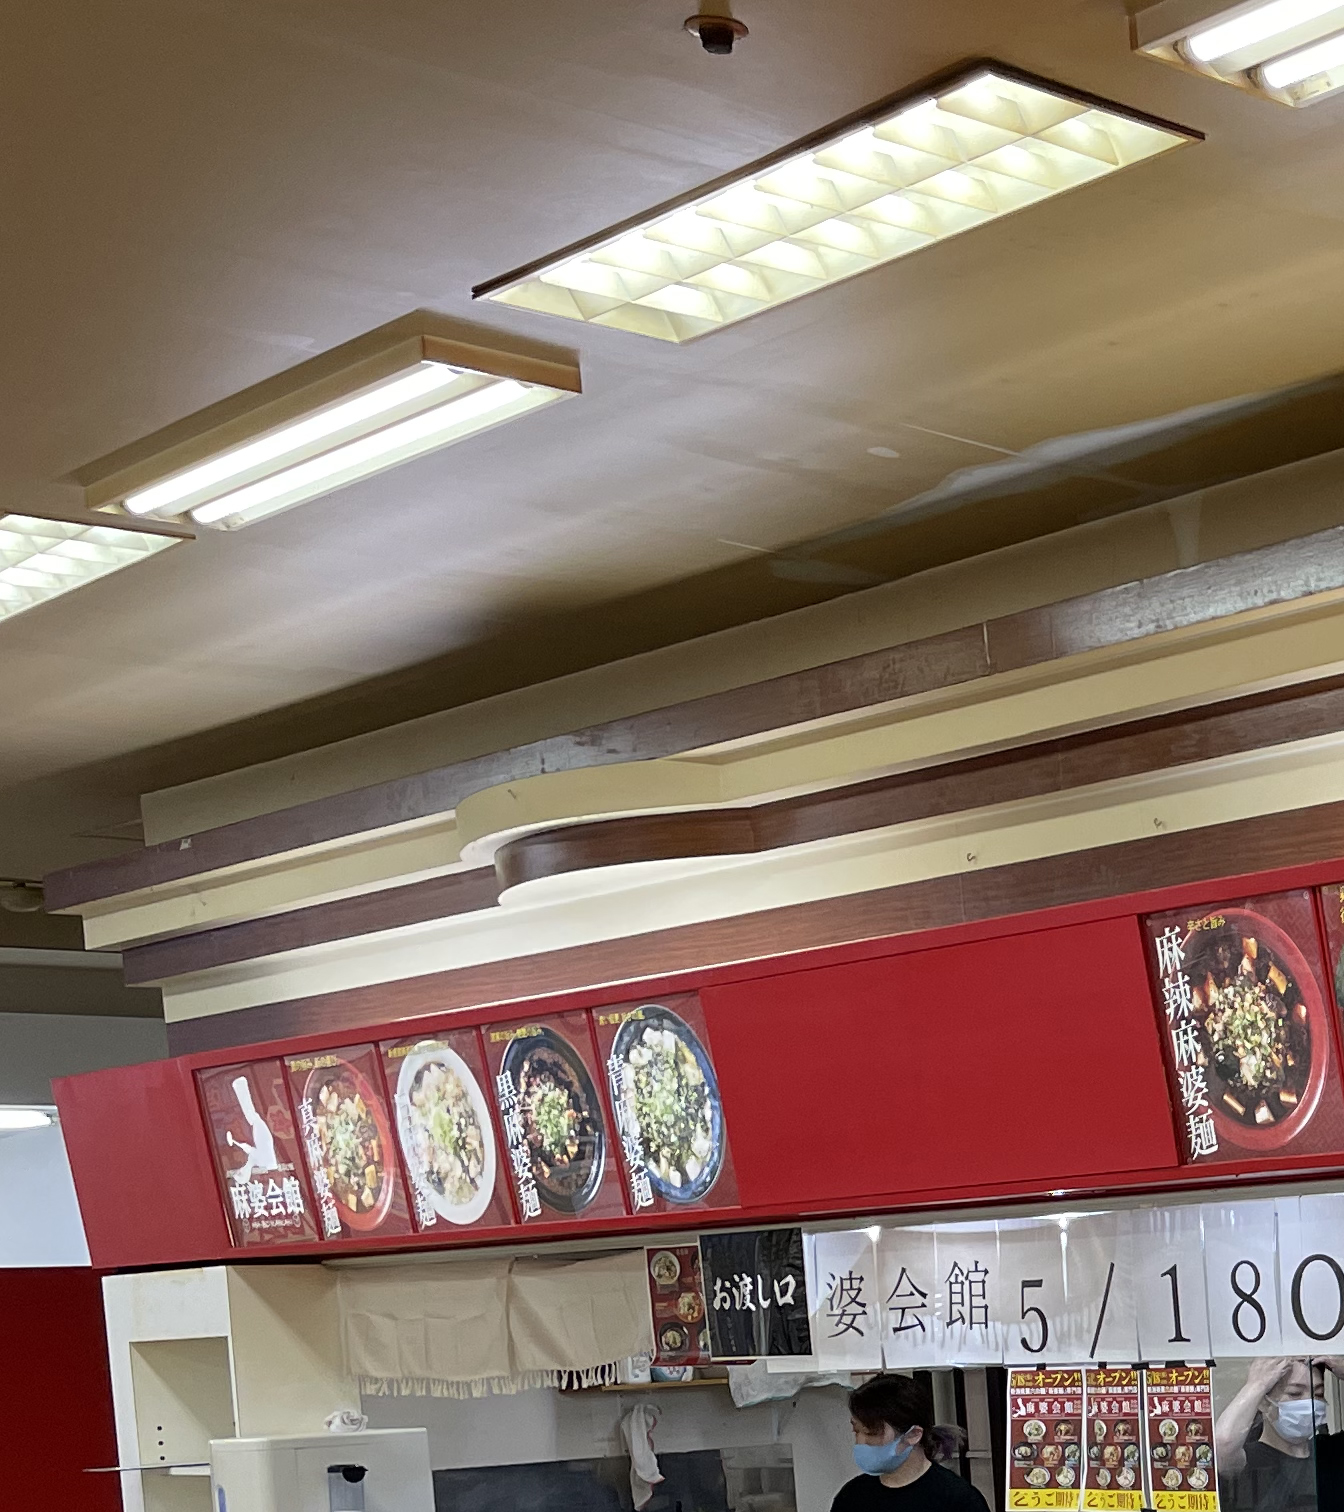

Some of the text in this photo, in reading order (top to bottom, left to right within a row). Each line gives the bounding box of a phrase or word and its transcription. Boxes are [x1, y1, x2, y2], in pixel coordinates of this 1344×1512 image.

[1154, 925, 1219, 1160] 麻辣麻婆麺
[496, 1070, 542, 1221] 黒麻婆麺
[230, 1176, 305, 1219] 麻婆会館
[713, 1271, 797, 1312] お渡し口
[826, 1260, 990, 1340] 婆会館
